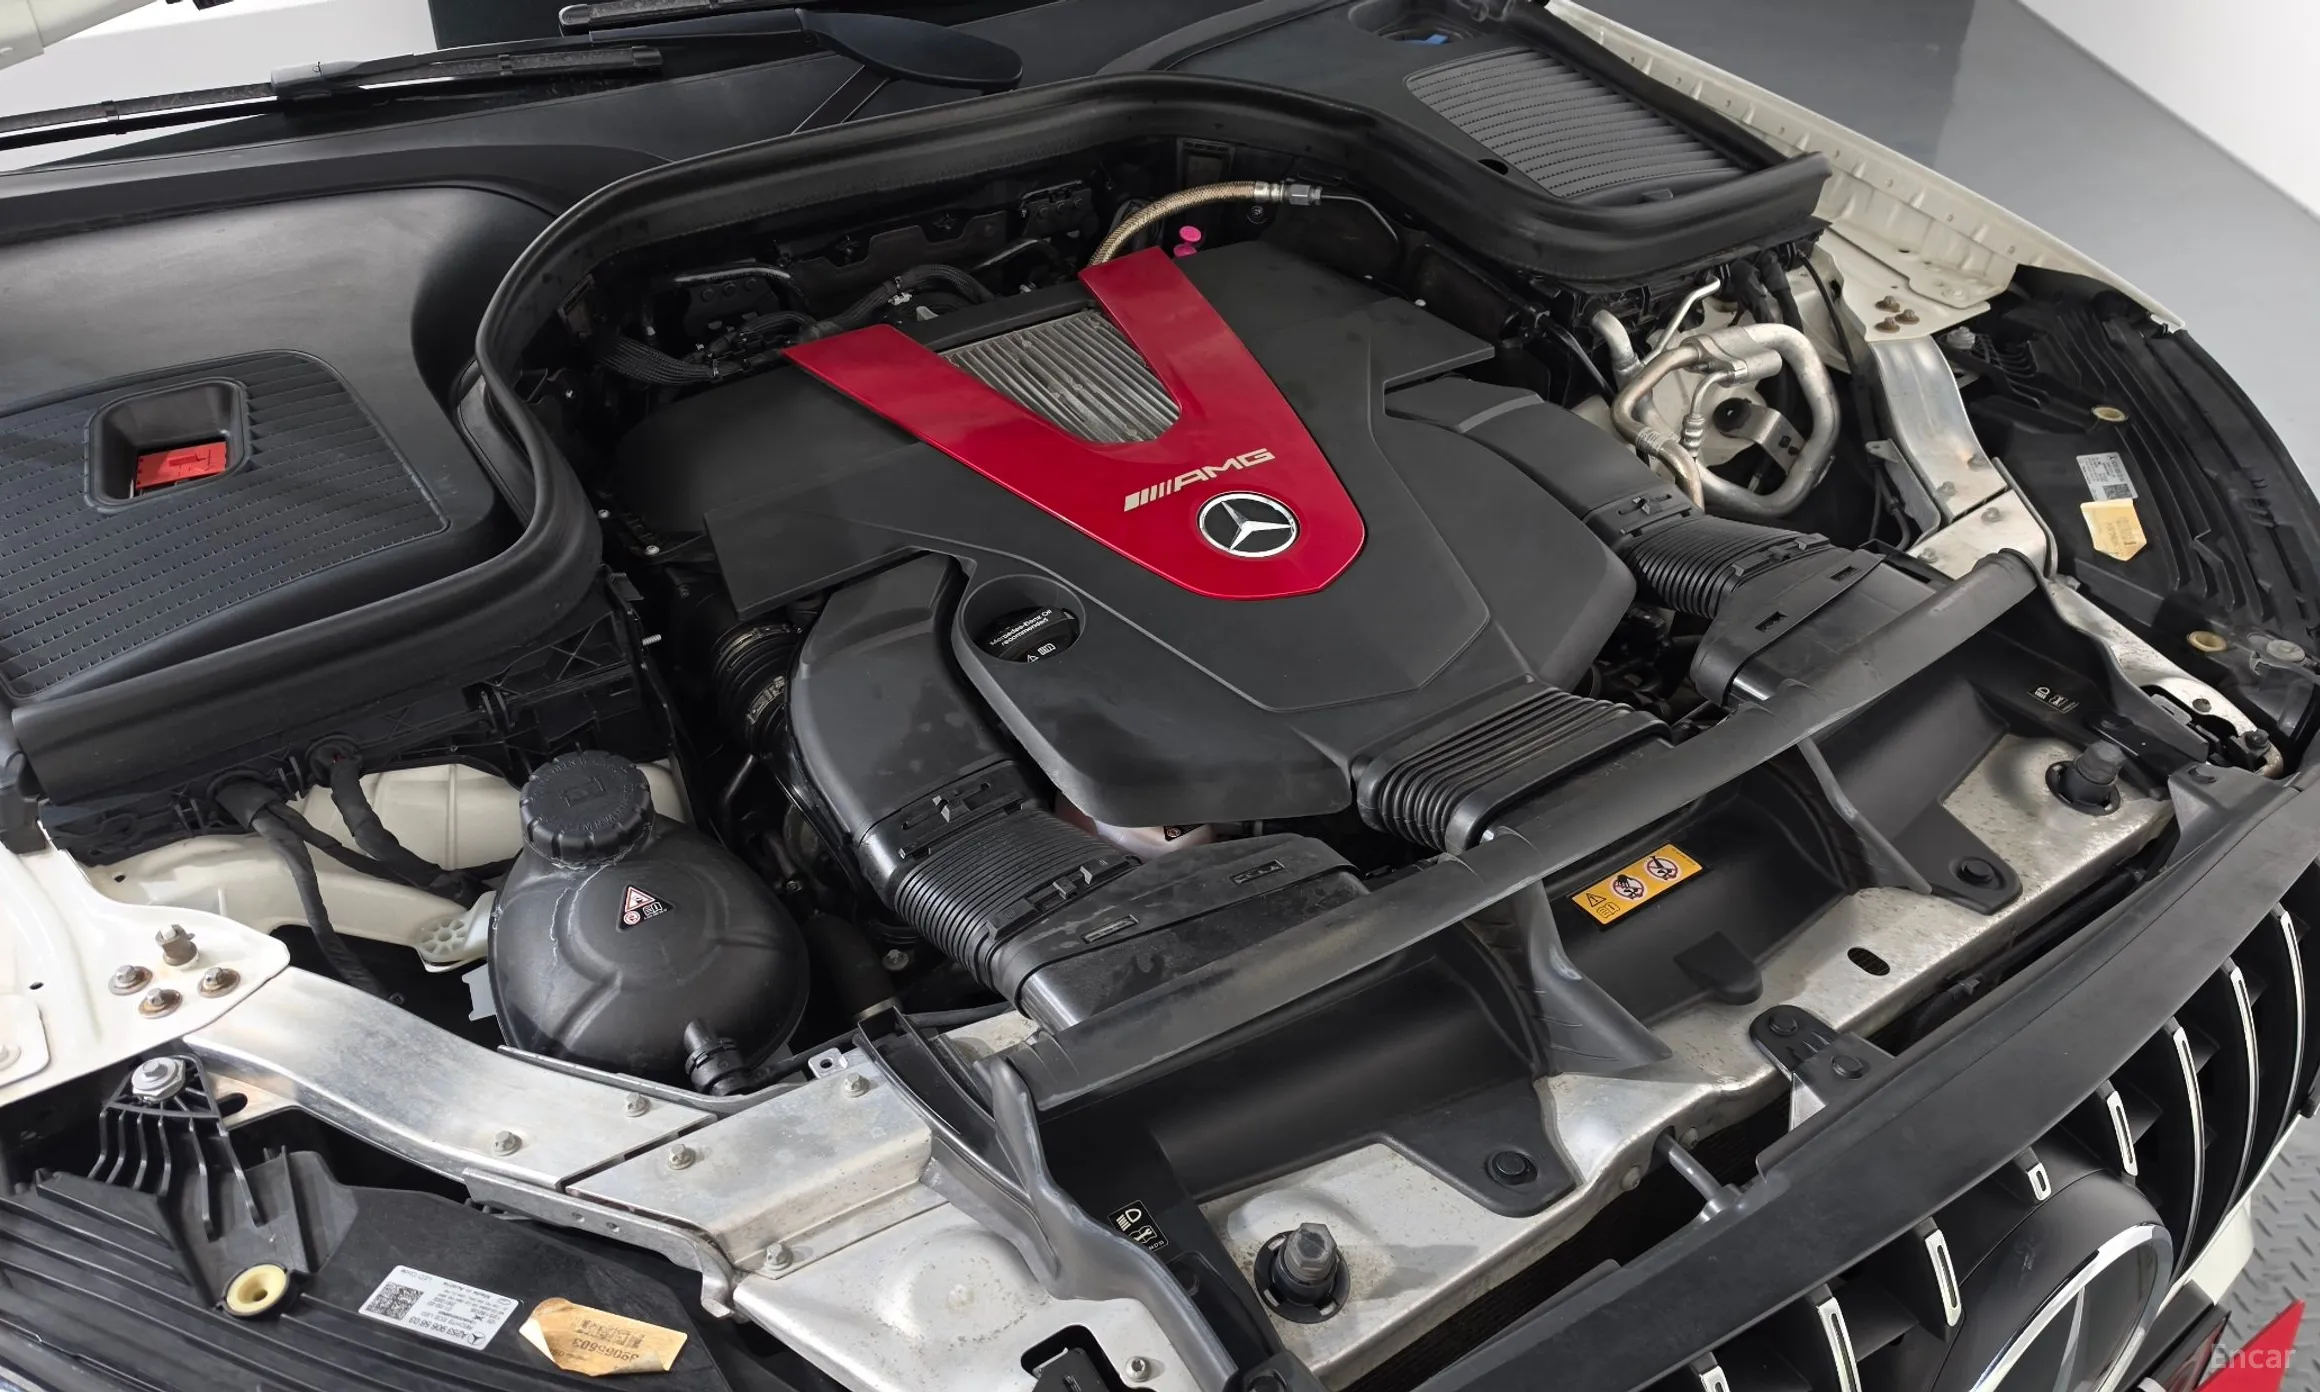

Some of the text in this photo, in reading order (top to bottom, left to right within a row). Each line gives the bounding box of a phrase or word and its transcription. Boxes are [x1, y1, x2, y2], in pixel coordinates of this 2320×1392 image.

[1174, 448, 1275, 492] AMG
[989, 614, 1042, 646] Mercedes-Benz
[1001, 617, 1049, 646] recommended
